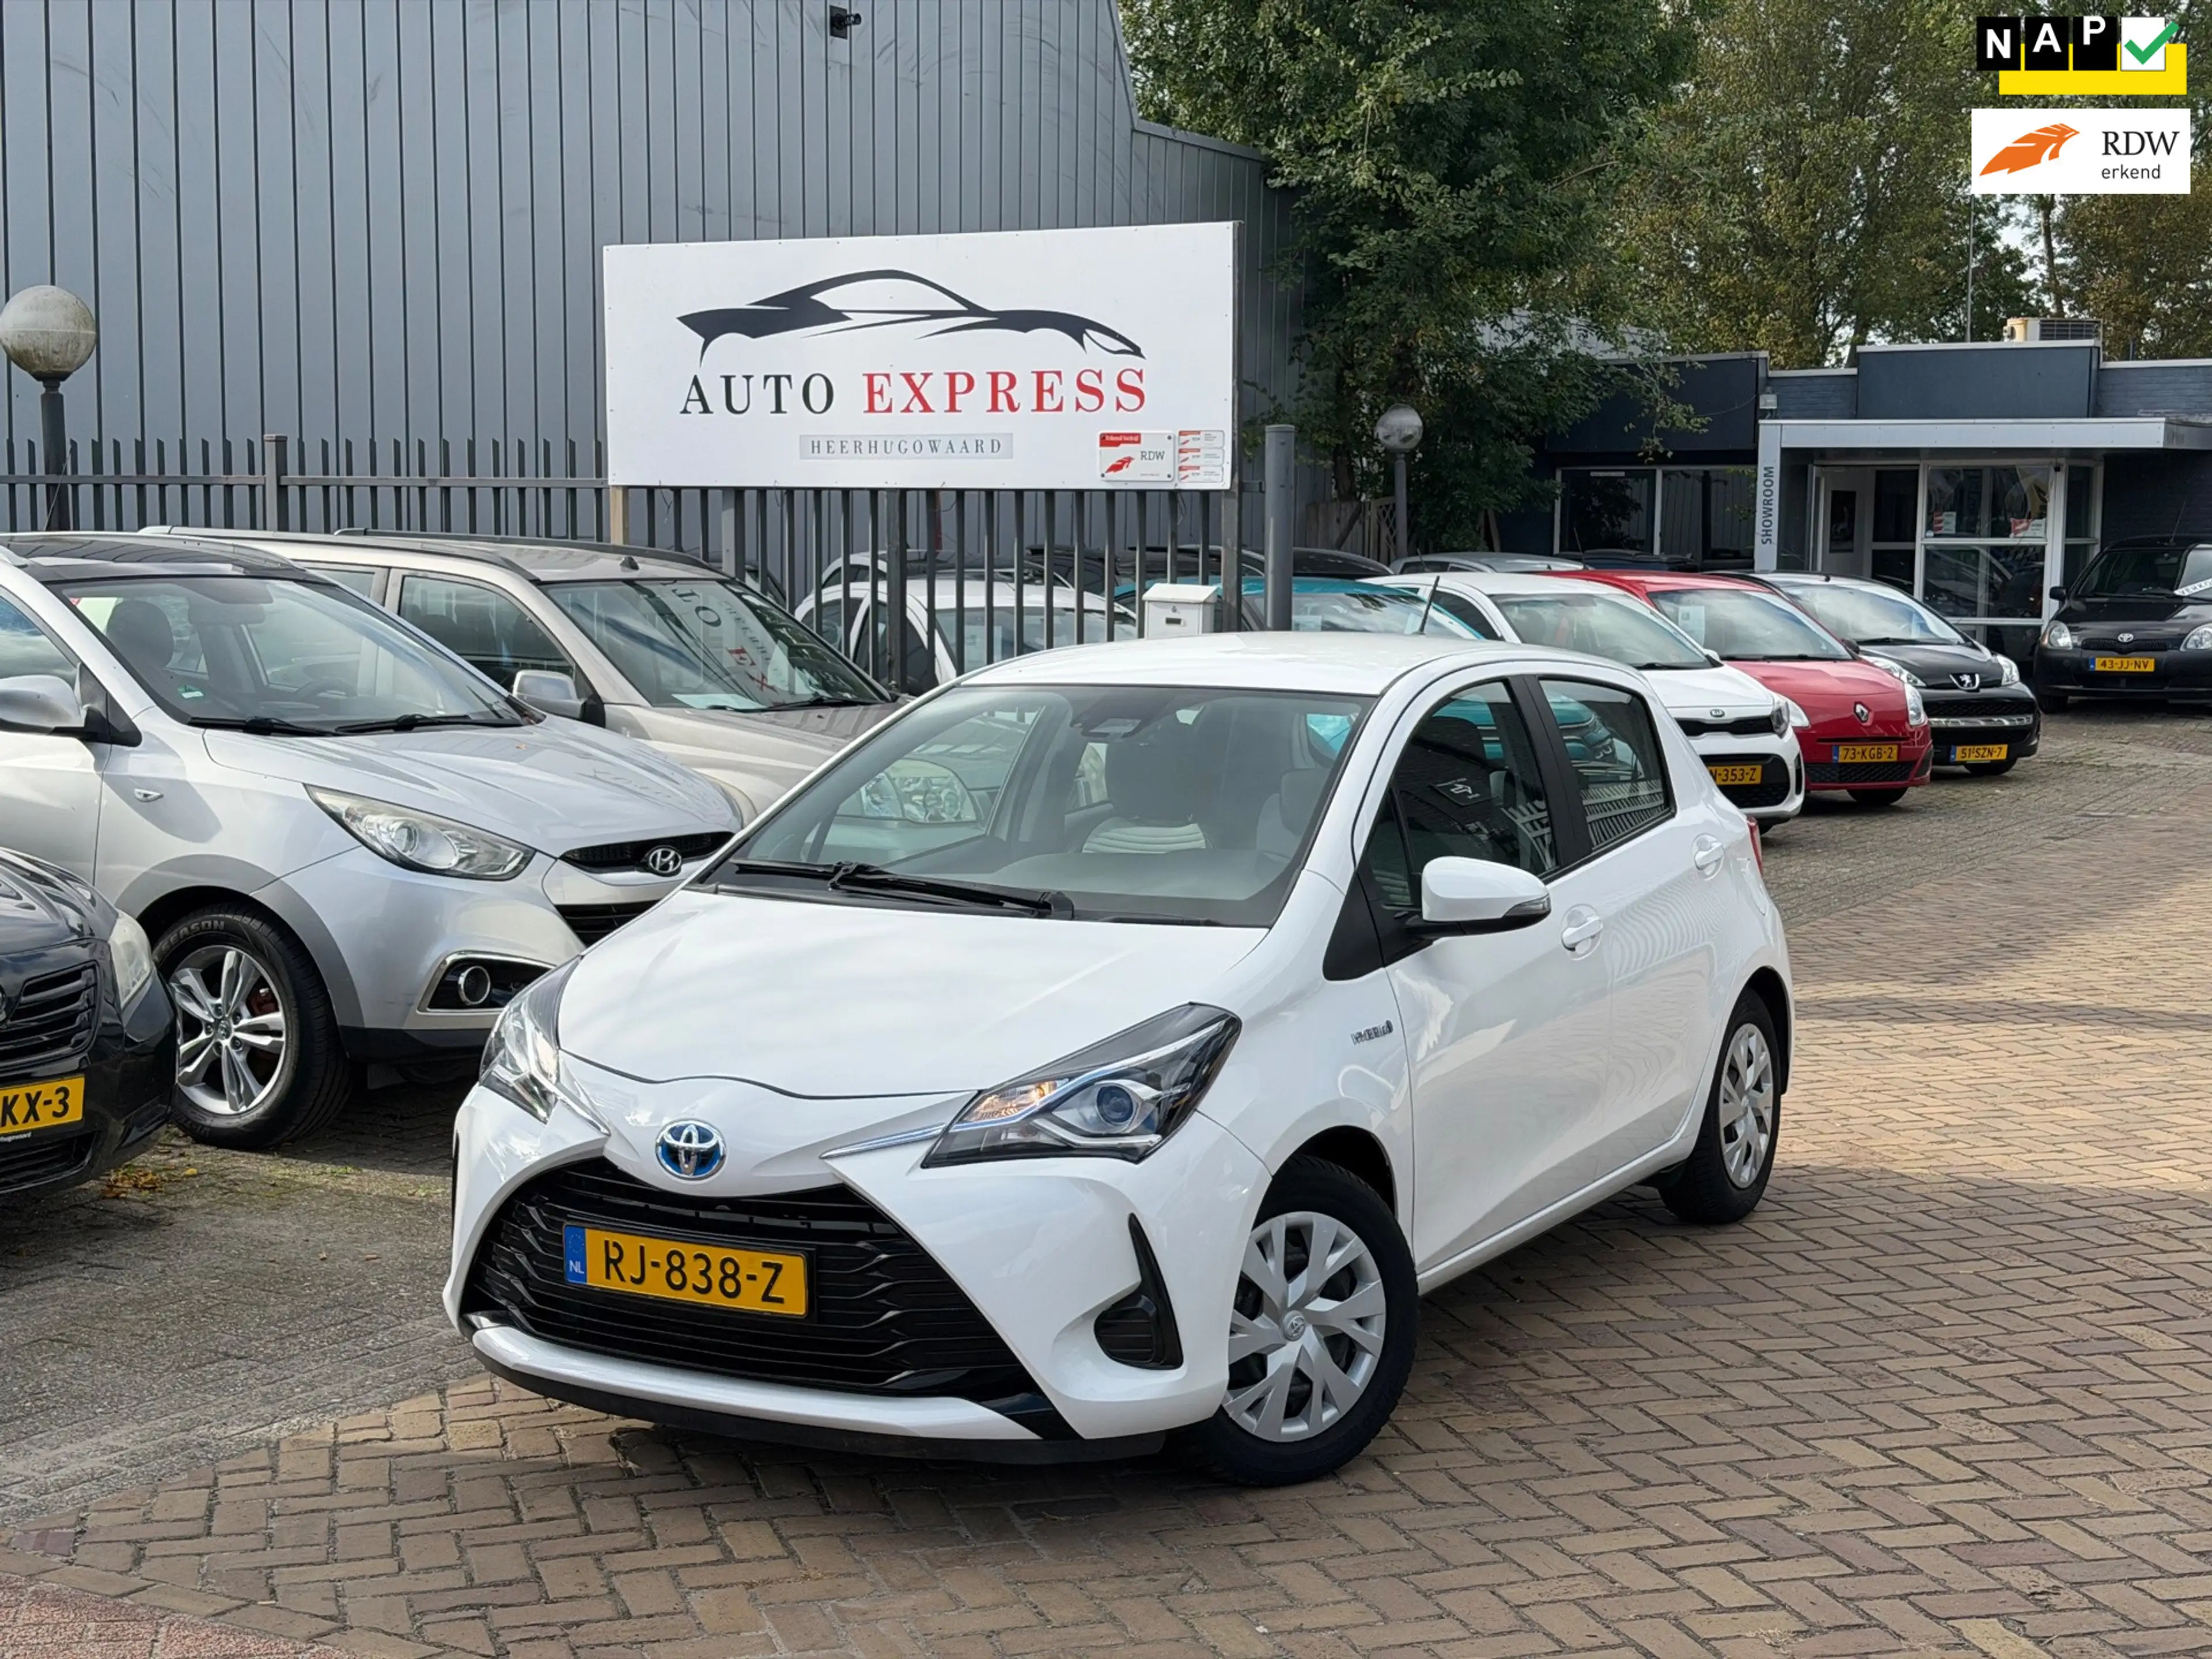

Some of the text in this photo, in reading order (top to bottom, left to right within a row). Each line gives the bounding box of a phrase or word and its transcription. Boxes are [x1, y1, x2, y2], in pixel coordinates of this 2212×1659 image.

[679, 369, 1146, 414] AUTO EXPRESS
[810, 440, 1002, 454] HEERHUGOWAARD
[1140, 450, 1165, 461] RDW
[1761, 466, 1775, 545] SHOWROOM
[2100, 659, 2149, 670] 43-JJ-NV
[1843, 747, 1893, 760] 73-KGB-2
[1, 1086, 70, 1127] KX-3
[569, 1259, 585, 1274] NL
[604, 1238, 785, 1304] RJ-838-Z
